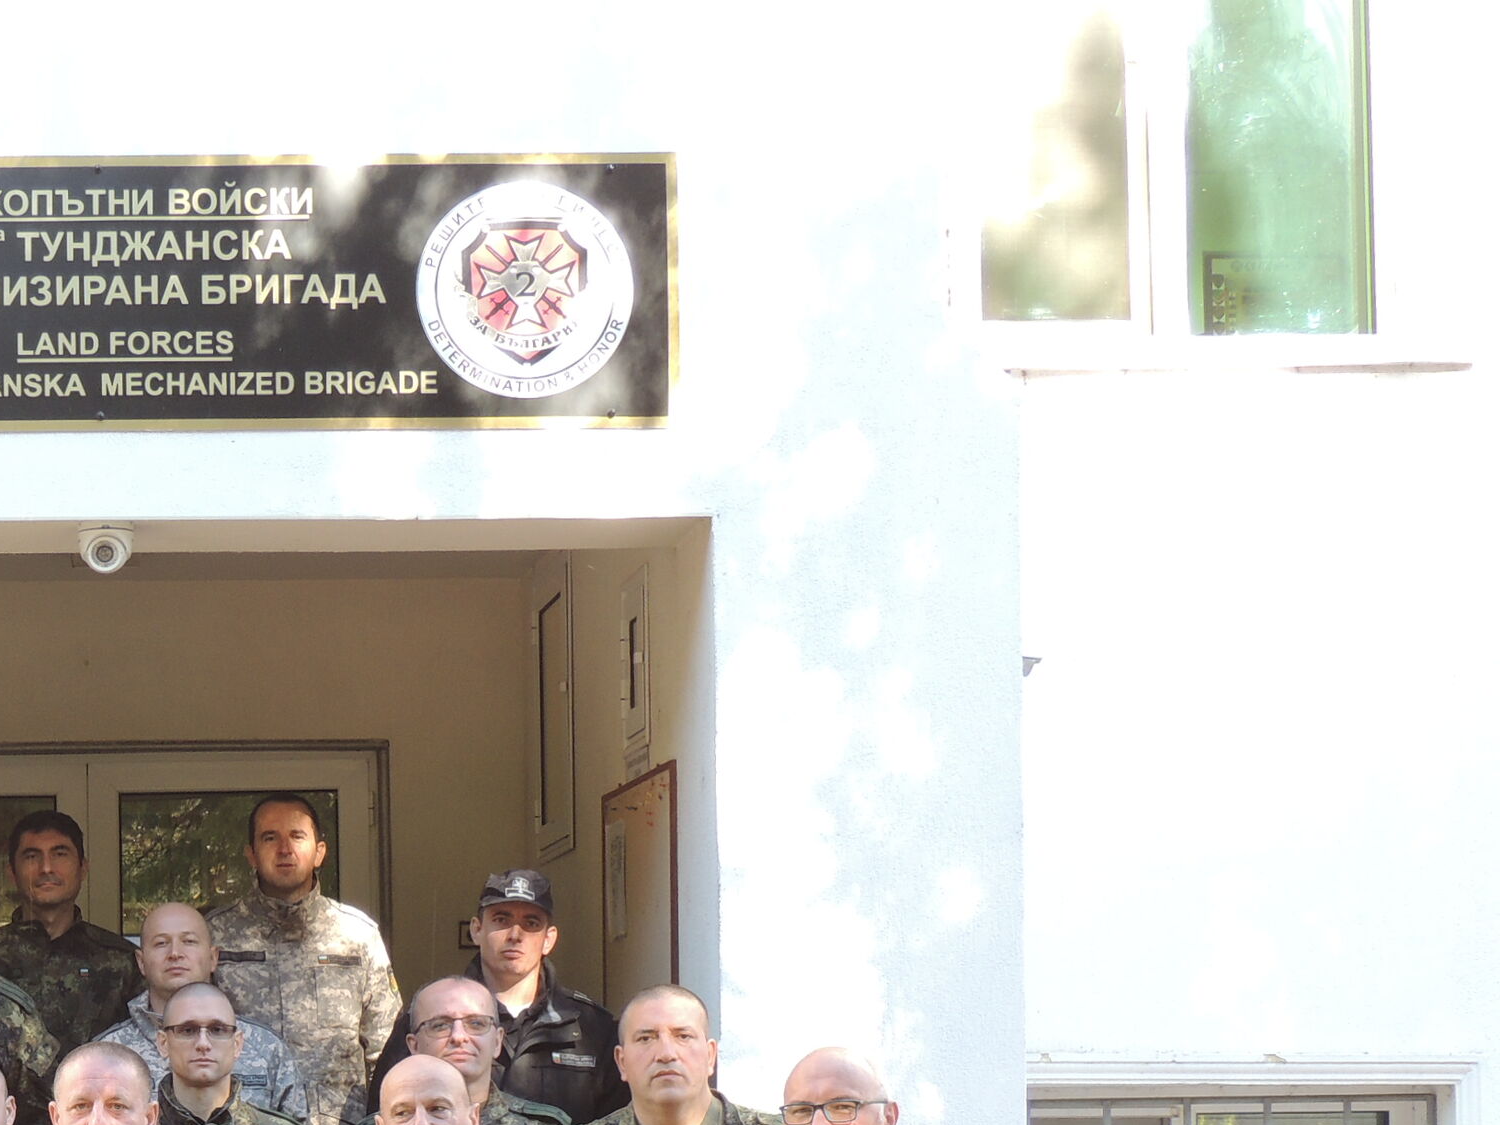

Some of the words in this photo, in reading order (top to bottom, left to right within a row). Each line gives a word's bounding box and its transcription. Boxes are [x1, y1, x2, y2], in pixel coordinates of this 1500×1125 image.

[168, 180, 313, 215] ВОЙСКИ
[16, 229, 292, 268] ТУНДЖАНСКА
[201, 273, 388, 310] БРИГАДА
[515, 272, 537, 297] 2
[16, 332, 100, 356] LAND
[109, 331, 235, 355] FORCES
[469, 315, 488, 335] ЗА
[494, 320, 578, 349] БЪЛГАРИ
[427, 319, 558, 393] DETERMINATION
[577, 319, 624, 374] HONOR
[101, 371, 296, 396] MECHANIZED
[304, 370, 438, 395] BRIGADE
